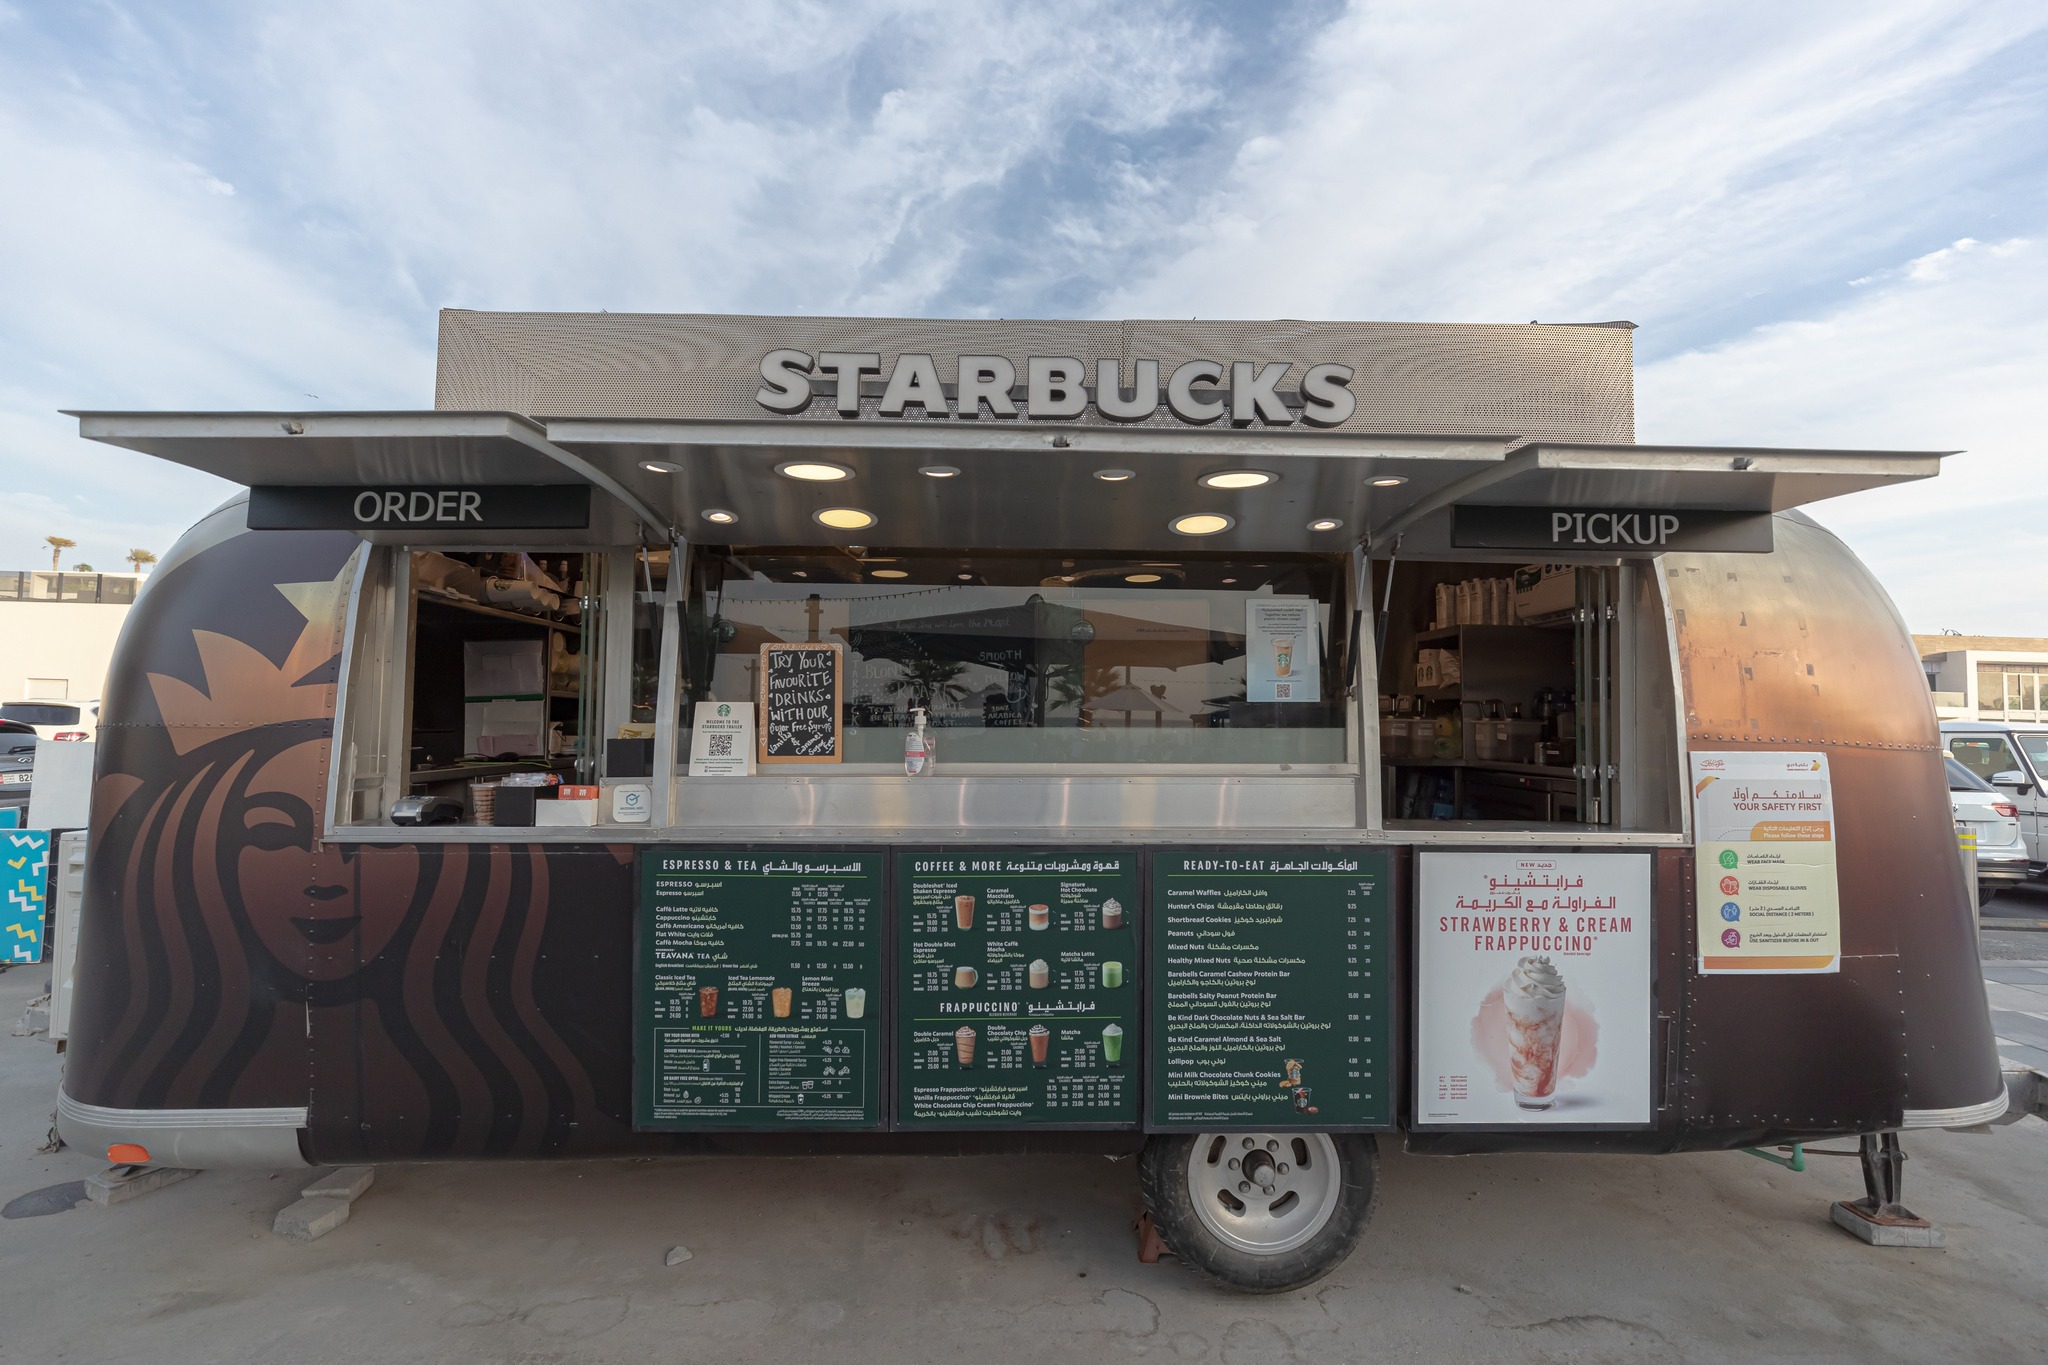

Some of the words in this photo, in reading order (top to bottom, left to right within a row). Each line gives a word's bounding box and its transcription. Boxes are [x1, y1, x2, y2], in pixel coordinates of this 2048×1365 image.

[754, 348, 1356, 428] STARBUCKS
[353, 490, 482, 523] ORDER
[1552, 513, 1679, 544] PICKUP
[770, 651, 793, 669] TRY
[798, 652, 825, 670] YOUR
[979, 650, 1022, 661] SMOOTH
[807, 706, 828, 718] OUR
[770, 723, 789, 734] Sugar
[792, 722, 807, 732] Free
[1733, 803, 1759, 811] YOUR
[1762, 803, 1796, 811] SAFETY
[1799, 803, 1822, 811] FIRST
[663, 860, 719, 870] ESPRESSO
[724, 860, 732, 870] &
[738, 861, 757, 870] TEA
[915, 862, 954, 871] COFFEE
[959, 862, 967, 871] &
[972, 862, 1001, 871] MORE
[1093, 860, 1119, 871] قهوة
[1184, 861, 1265, 871] READY-TO-EAT
[1456, 895, 1522, 912] الكريمة
[1526, 899, 1548, 912] مع
[1552, 896, 1615, 912] الفراولة
[1440, 917, 1551, 932] STRAWBERRY
[1558, 917, 1569, 932] &
[1576, 917, 1632, 932] CREAM
